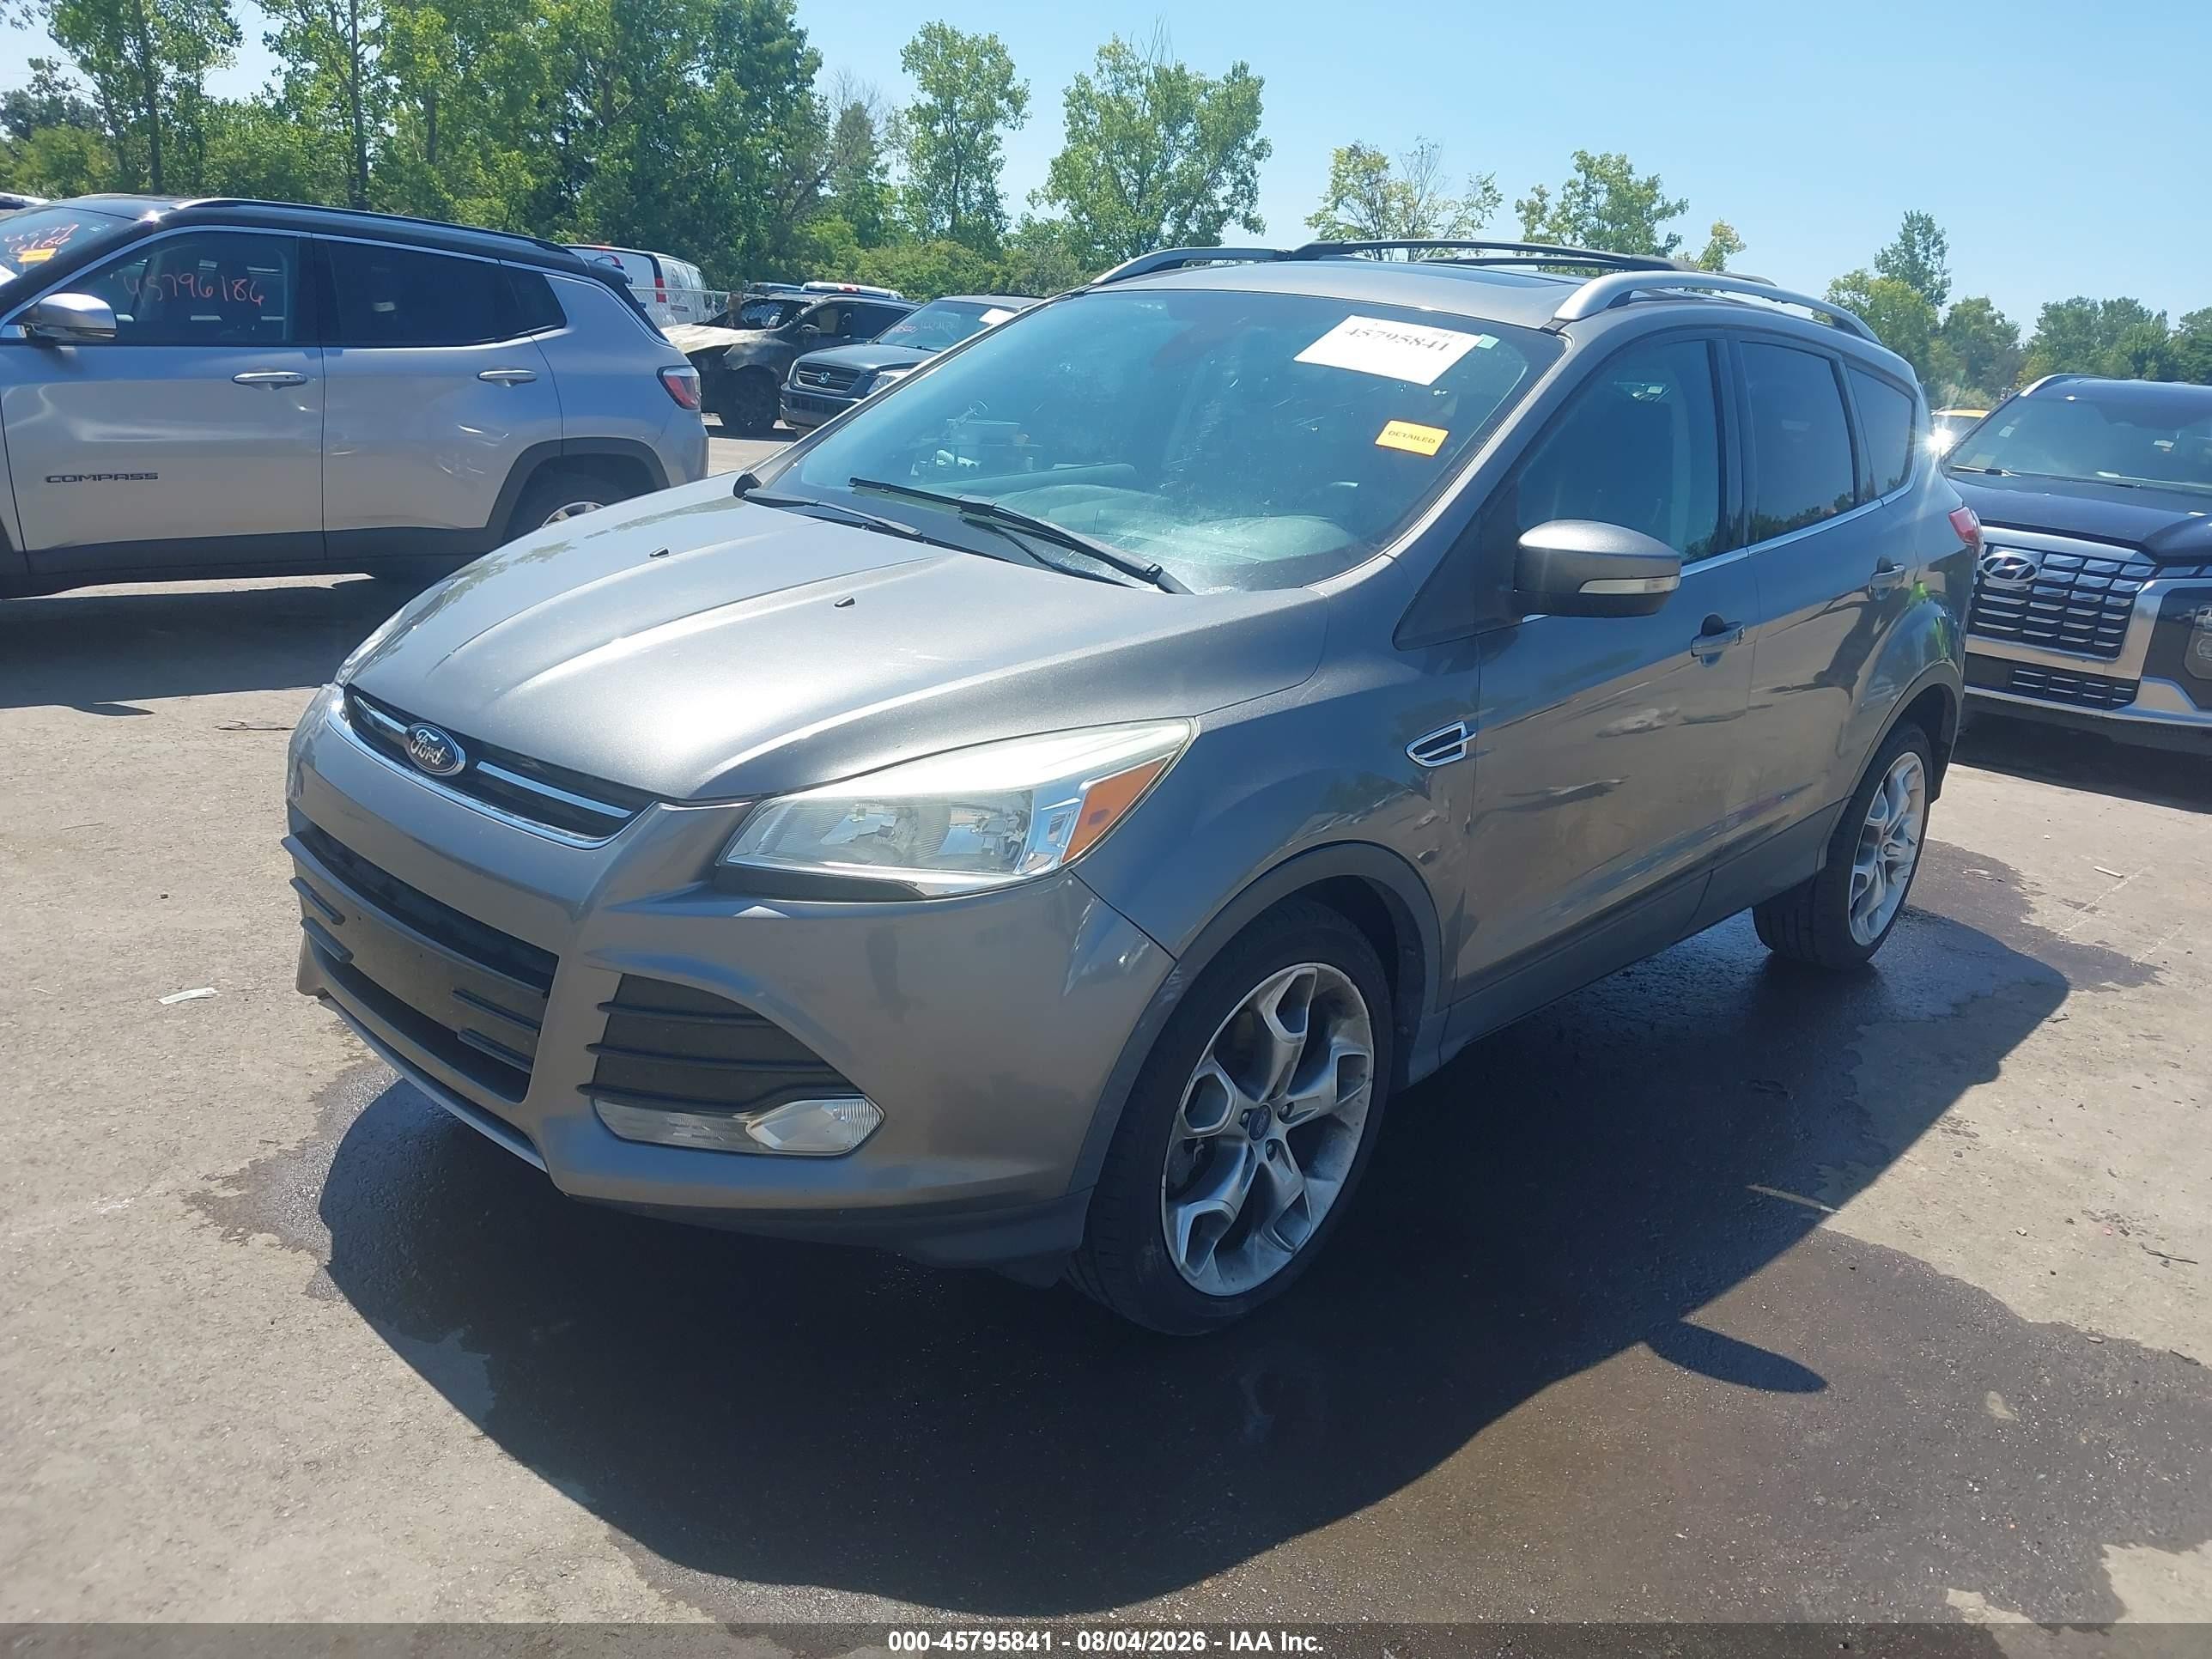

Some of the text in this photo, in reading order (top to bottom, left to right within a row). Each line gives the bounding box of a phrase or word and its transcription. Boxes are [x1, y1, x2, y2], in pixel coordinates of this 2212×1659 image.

[124, 272, 264, 307] 45796186
[1345, 328, 1449, 350] 45795841
[1388, 430, 1436, 444] DETAILED
[46, 472, 159, 483] COMPASS
[410, 728, 448, 765] Ford
